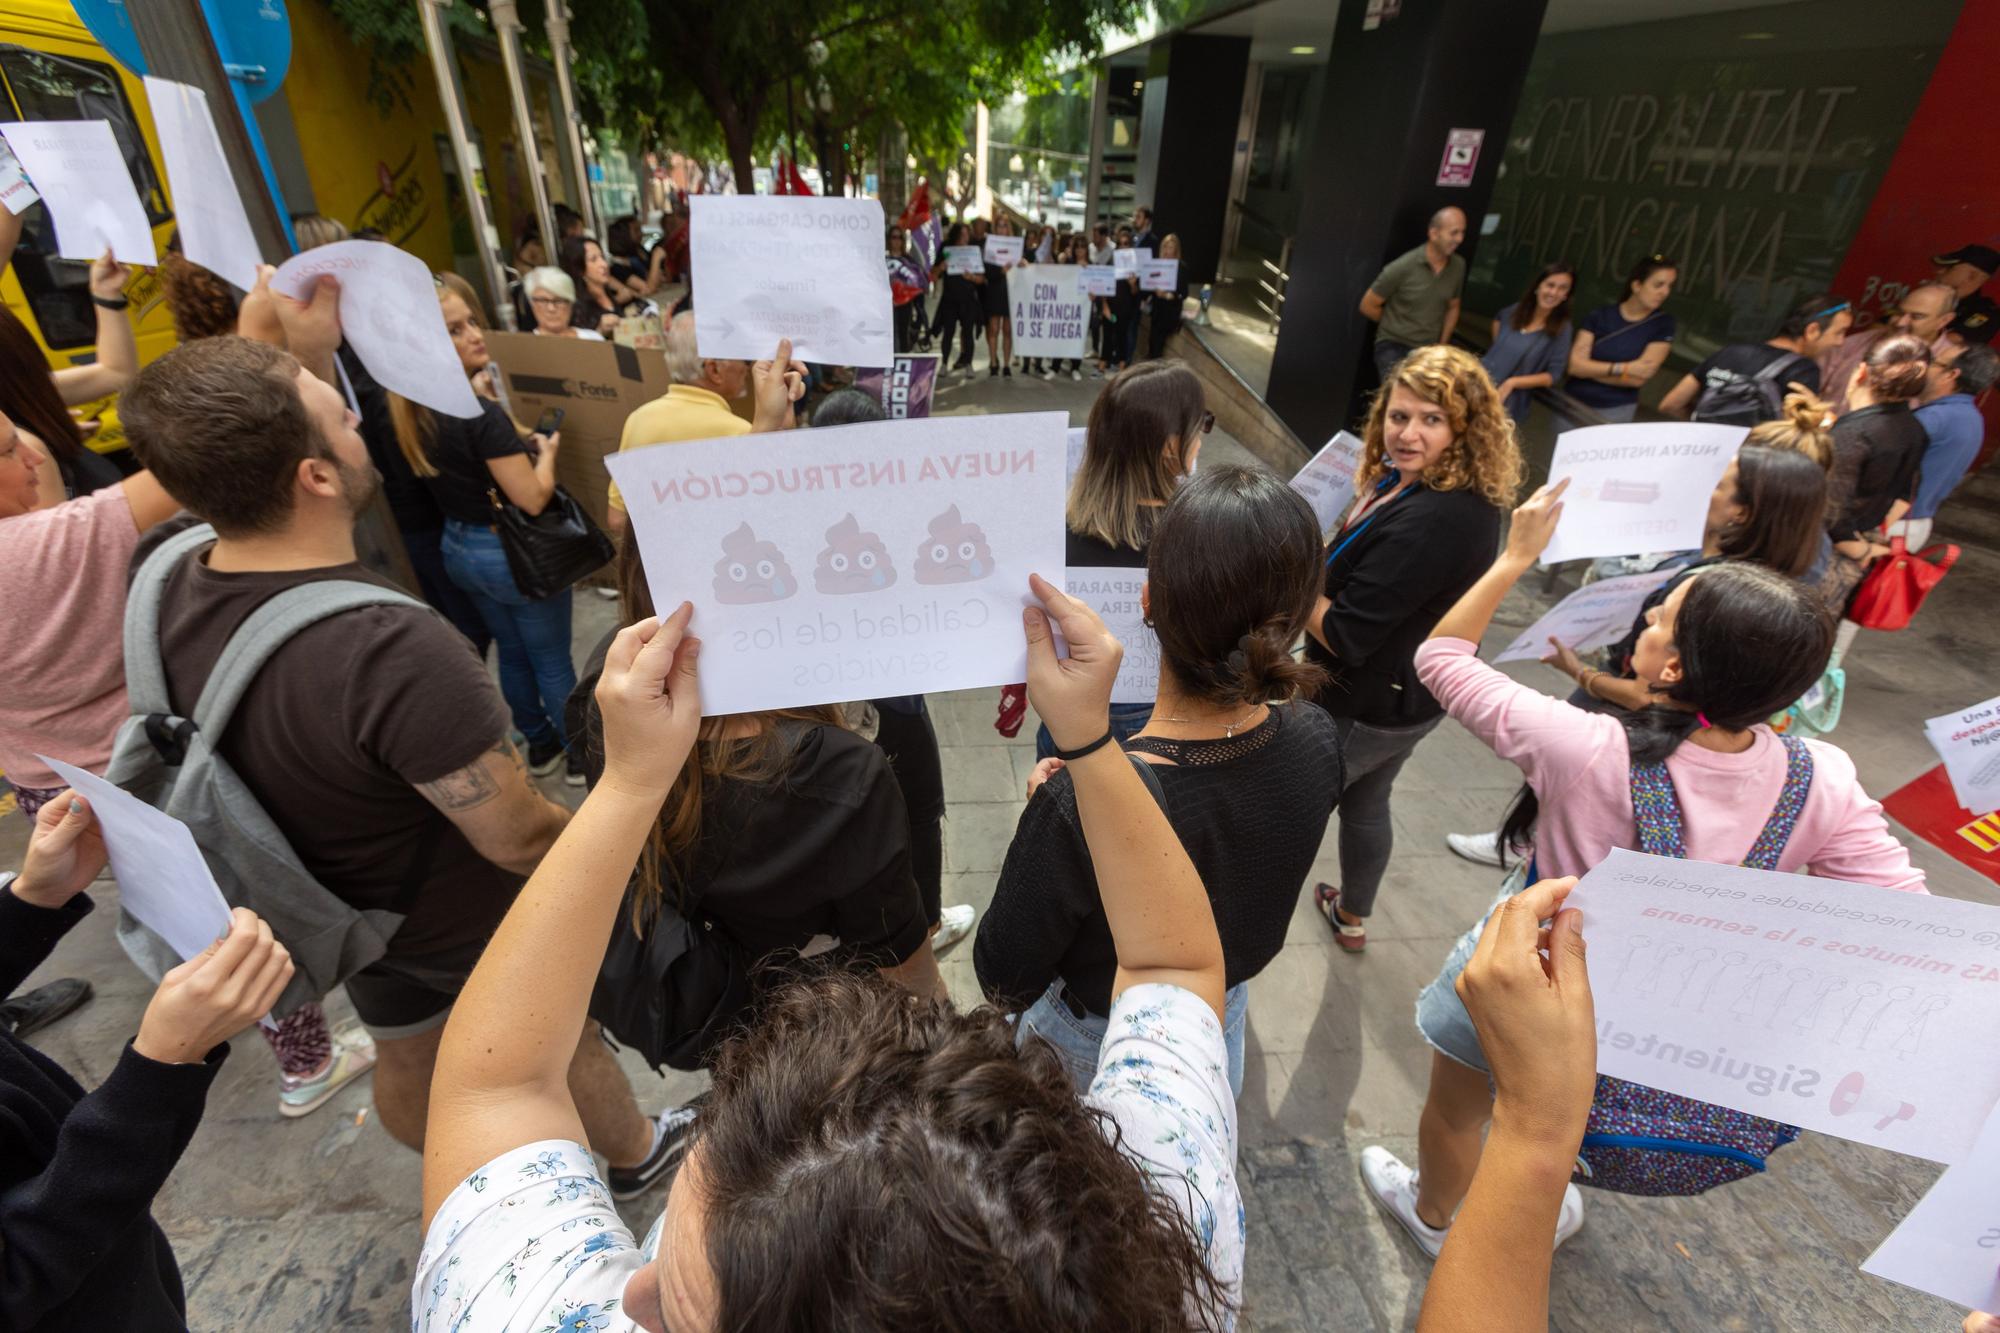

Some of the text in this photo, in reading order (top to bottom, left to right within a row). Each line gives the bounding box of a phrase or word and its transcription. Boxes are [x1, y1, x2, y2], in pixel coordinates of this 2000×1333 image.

[1527, 85, 1856, 193] GENERALITAT
[1503, 193, 1787, 302] VALENCIANA
[1034, 283, 1058, 301] CON
[1029, 302, 1082, 320] INFANCIA
[1029, 321, 1043, 338] SE
[1048, 322, 1082, 339] JUEGA
[890, 359, 912, 419] CCOO
[1962, 709, 1992, 724] Una
